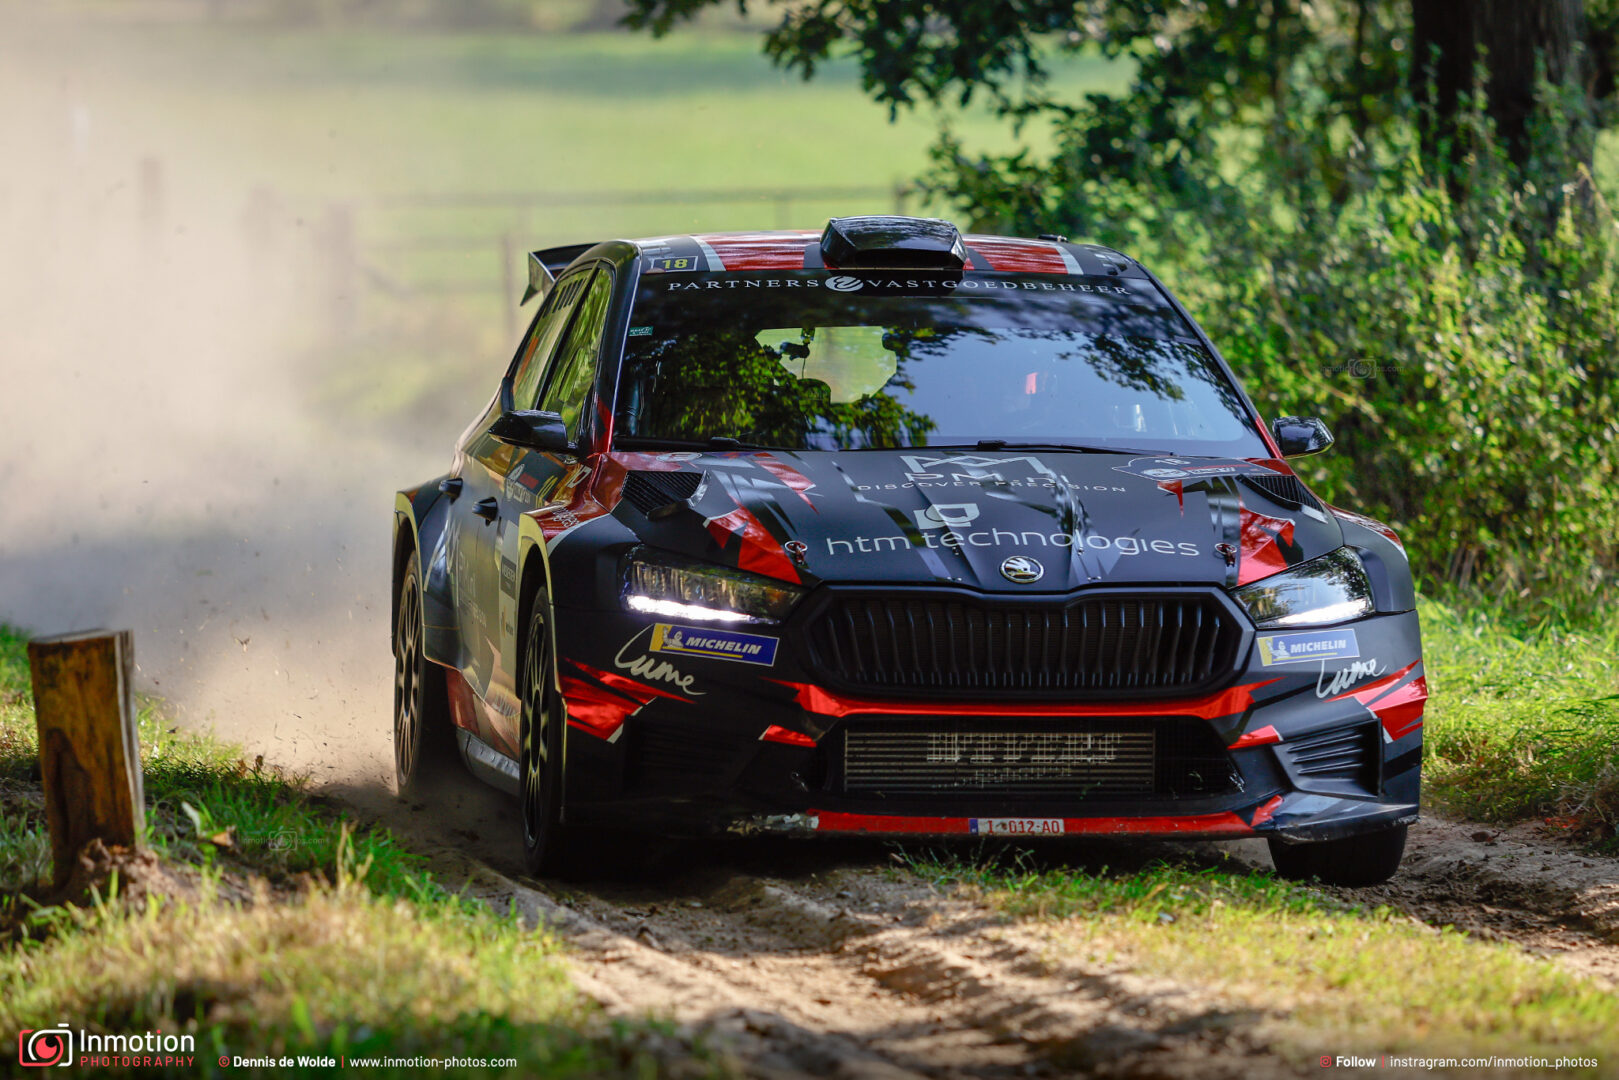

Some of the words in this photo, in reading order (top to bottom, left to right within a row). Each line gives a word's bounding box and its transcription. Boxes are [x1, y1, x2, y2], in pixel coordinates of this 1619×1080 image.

[662, 258, 688, 269] 18
[667, 279, 820, 291] PARTNERS
[866, 279, 1131, 295] VASTGOEDBEHEER
[857, 480, 982, 491] DISCOVER
[995, 480, 1126, 492] PRECSION
[827, 537, 911, 556] htm
[917, 527, 1200, 557] technologies
[685, 636, 762, 655] MICHELIN
[1290, 639, 1347, 653] MICHELIN
